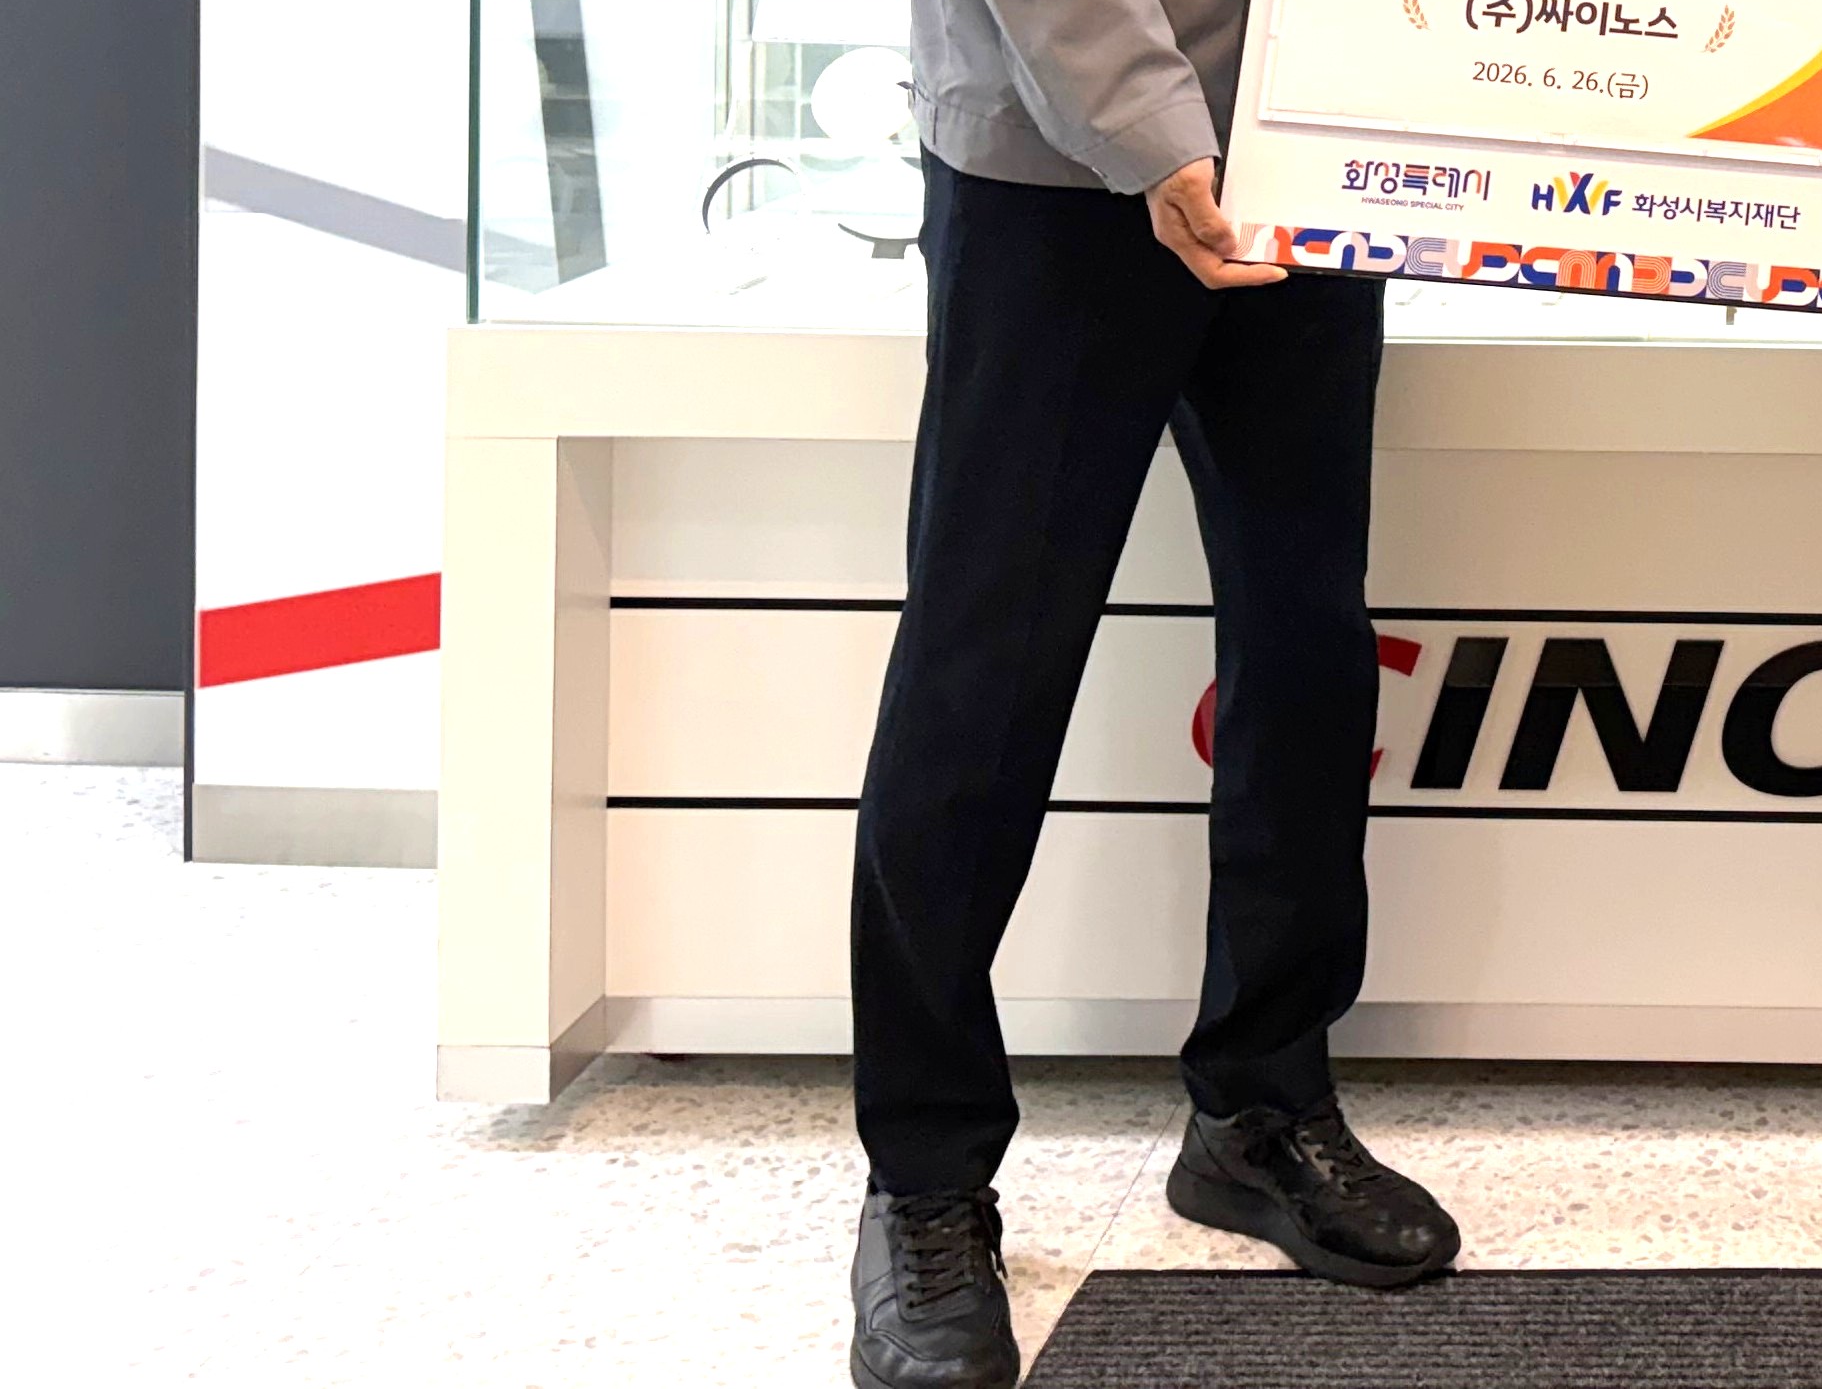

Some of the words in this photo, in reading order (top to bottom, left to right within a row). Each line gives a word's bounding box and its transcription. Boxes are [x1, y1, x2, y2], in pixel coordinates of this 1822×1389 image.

[1473, 61, 1533, 87] 2026.
[1543, 68, 1561, 89] 6.
[1572, 70, 1648, 99] 26.(금)
[1341, 160, 1491, 200] 화성특례시
[1410, 200, 1443, 210] SPECIAL
[1445, 203, 1464, 212] CITY
[1632, 193, 1801, 230] 화성시복지재단
